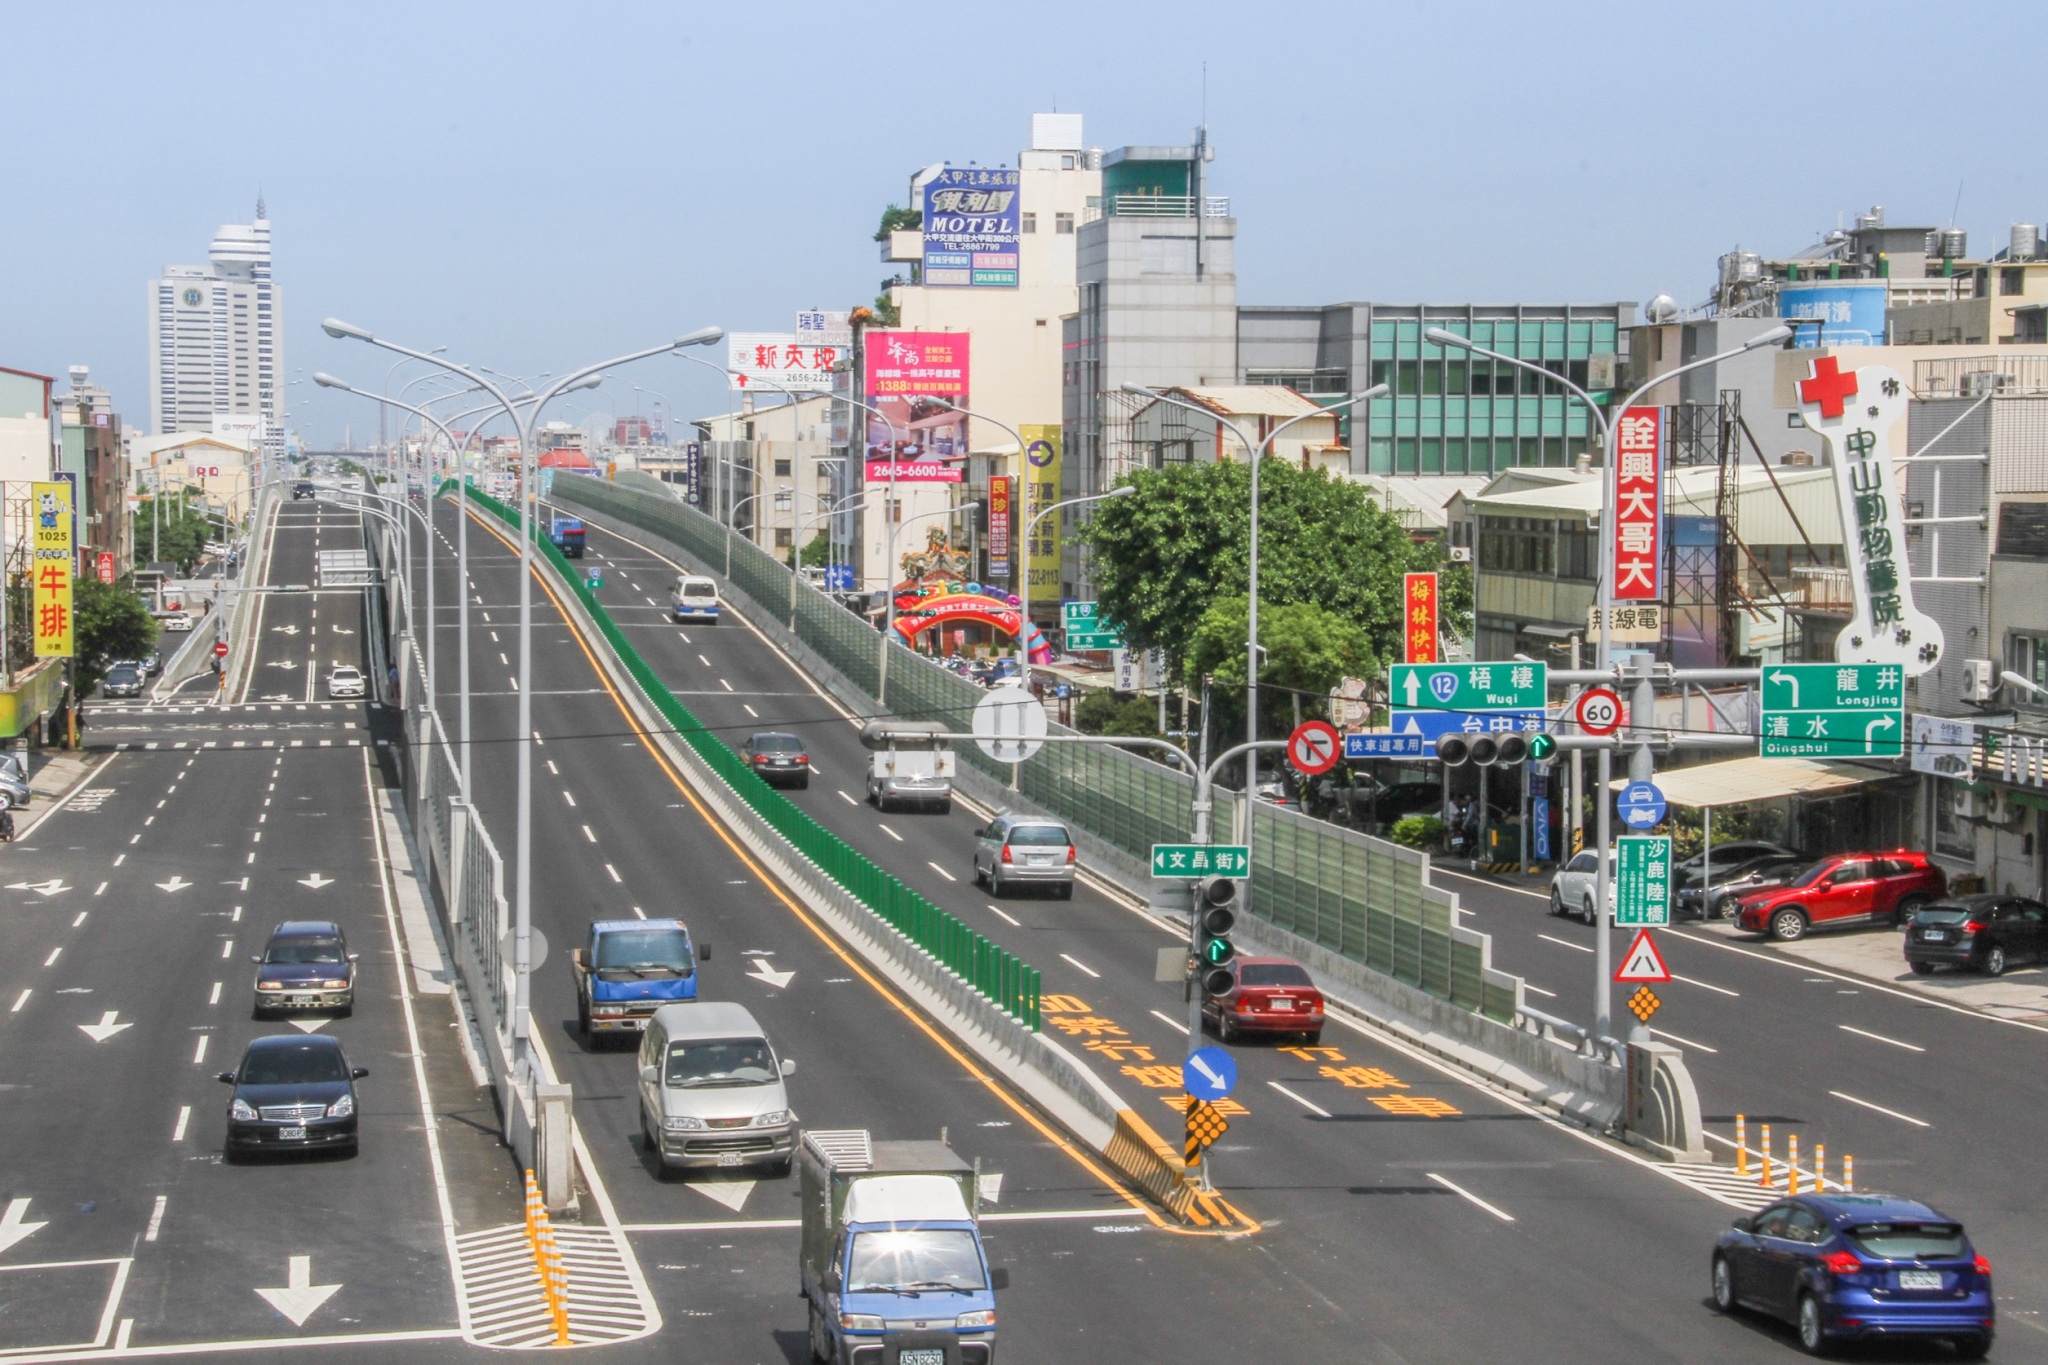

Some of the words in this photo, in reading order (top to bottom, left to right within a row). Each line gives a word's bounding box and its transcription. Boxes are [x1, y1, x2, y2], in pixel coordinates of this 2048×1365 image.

[931, 217, 1013, 233] MOTEL
[880, 380, 907, 391] 1388
[1618, 417, 1656, 590] 詮興大哥大
[38, 532, 67, 541] 1025
[1846, 427, 1904, 627] 中山動物醫院
[39, 565, 68, 638] 牛排
[1592, 609, 1659, 631] 無線電
[1436, 677, 1452, 694] 12
[1469, 666, 1534, 690] 梧棲
[1836, 667, 1899, 691] 龍井
[1486, 694, 1518, 706] Wuqi
[1836, 695, 1898, 707] Longjing
[1586, 705, 1612, 721] 60
[1461, 714, 1541, 733] 台中港
[1766, 715, 1829, 739] 清水
[1350, 739, 1420, 752] 快車道專用
[1767, 743, 1828, 755] Qingshui
[1169, 851, 1233, 870] 文昌街
[1646, 840, 1666, 923] 沙鹿陸橋
